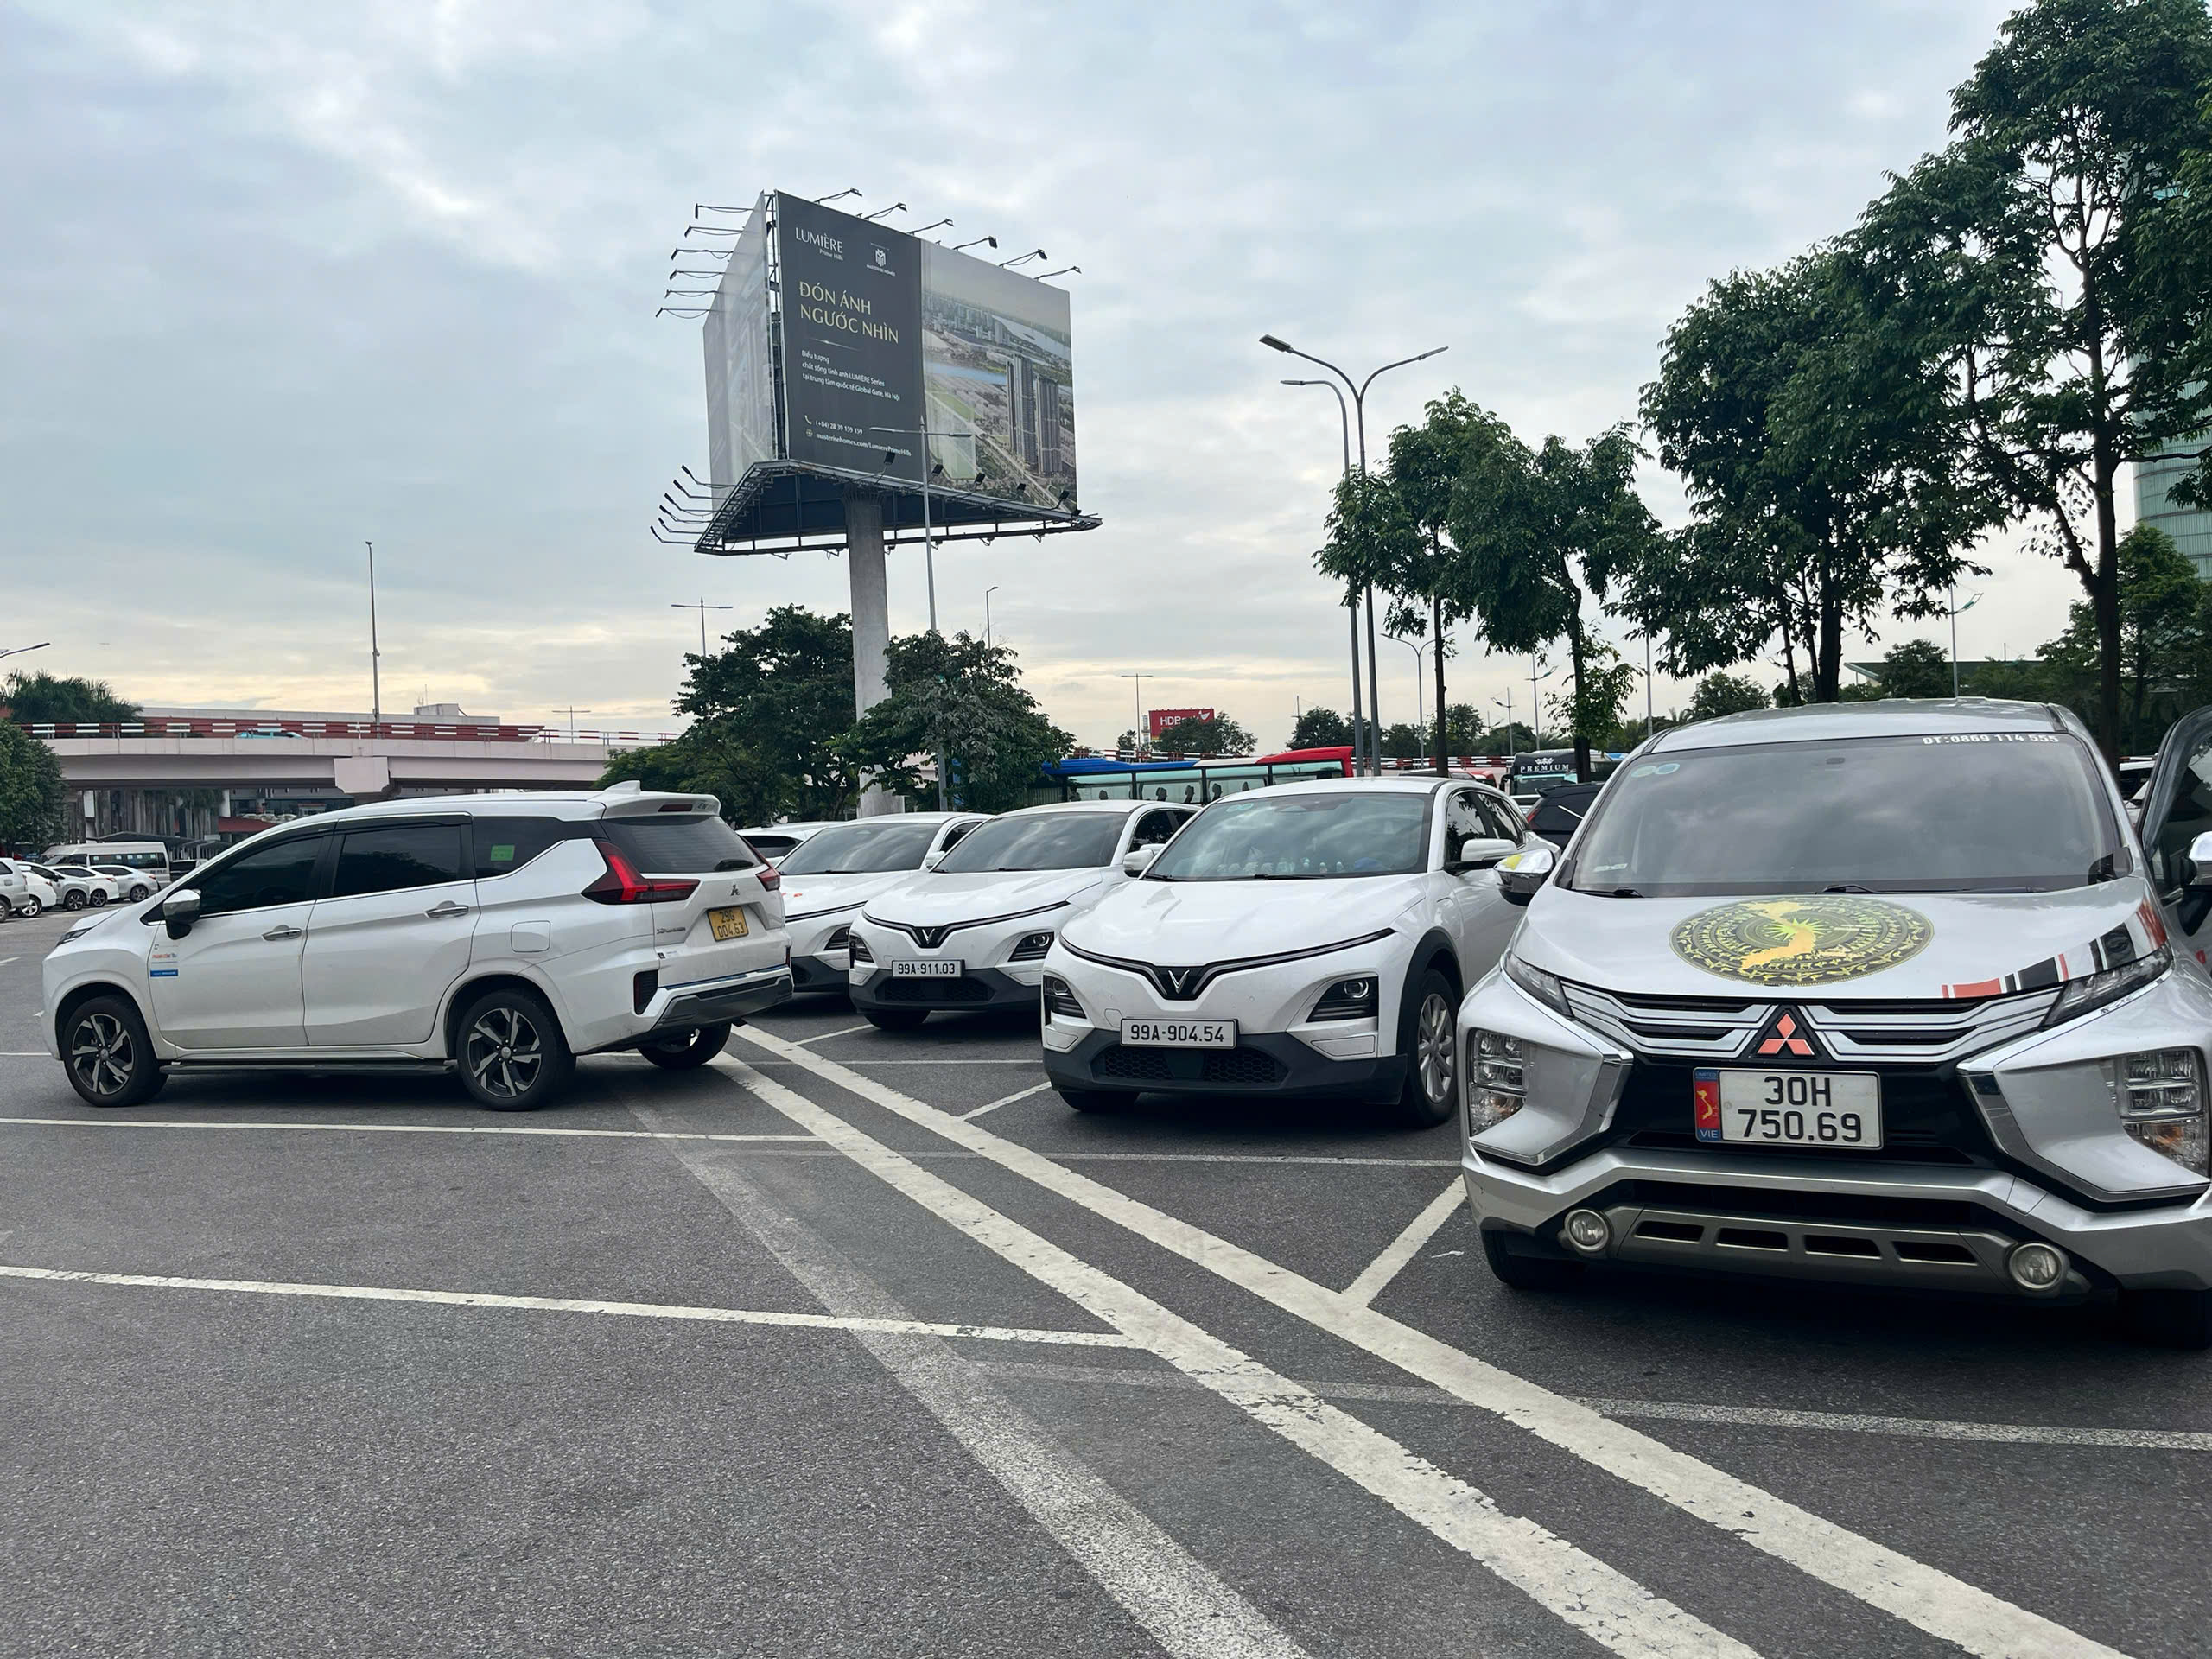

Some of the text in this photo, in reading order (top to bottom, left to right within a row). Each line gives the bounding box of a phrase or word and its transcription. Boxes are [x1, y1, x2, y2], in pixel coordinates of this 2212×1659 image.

[795, 226, 843, 254] LUMIÈRE
[799, 281, 871, 315] ĐÓN ÁNH
[800, 303, 899, 344] NGƯỚC NHÌN
[810, 374, 824, 385] trung
[825, 377, 836, 385] tâm
[836, 380, 849, 390] quốc
[855, 385, 871, 395] Global
[892, 393, 900, 402] Nội
[870, 378, 885, 387] Series
[815, 419, 830, 429] (+84)
[836, 423, 844, 432] 39
[854, 427, 863, 435] 159
[2028, 734, 2060, 743] 555
[1520, 764, 1569, 773] PREMIUM
[717, 922, 745, 938] 004.63
[898, 963, 955, 975] 99A-911.03
[1130, 1024, 1224, 1043] 99A-904.54
[1764, 1076, 1832, 1107] 30H
[1700, 1129, 1719, 1138] VIE
[1738, 1109, 1862, 1142] 750.69
